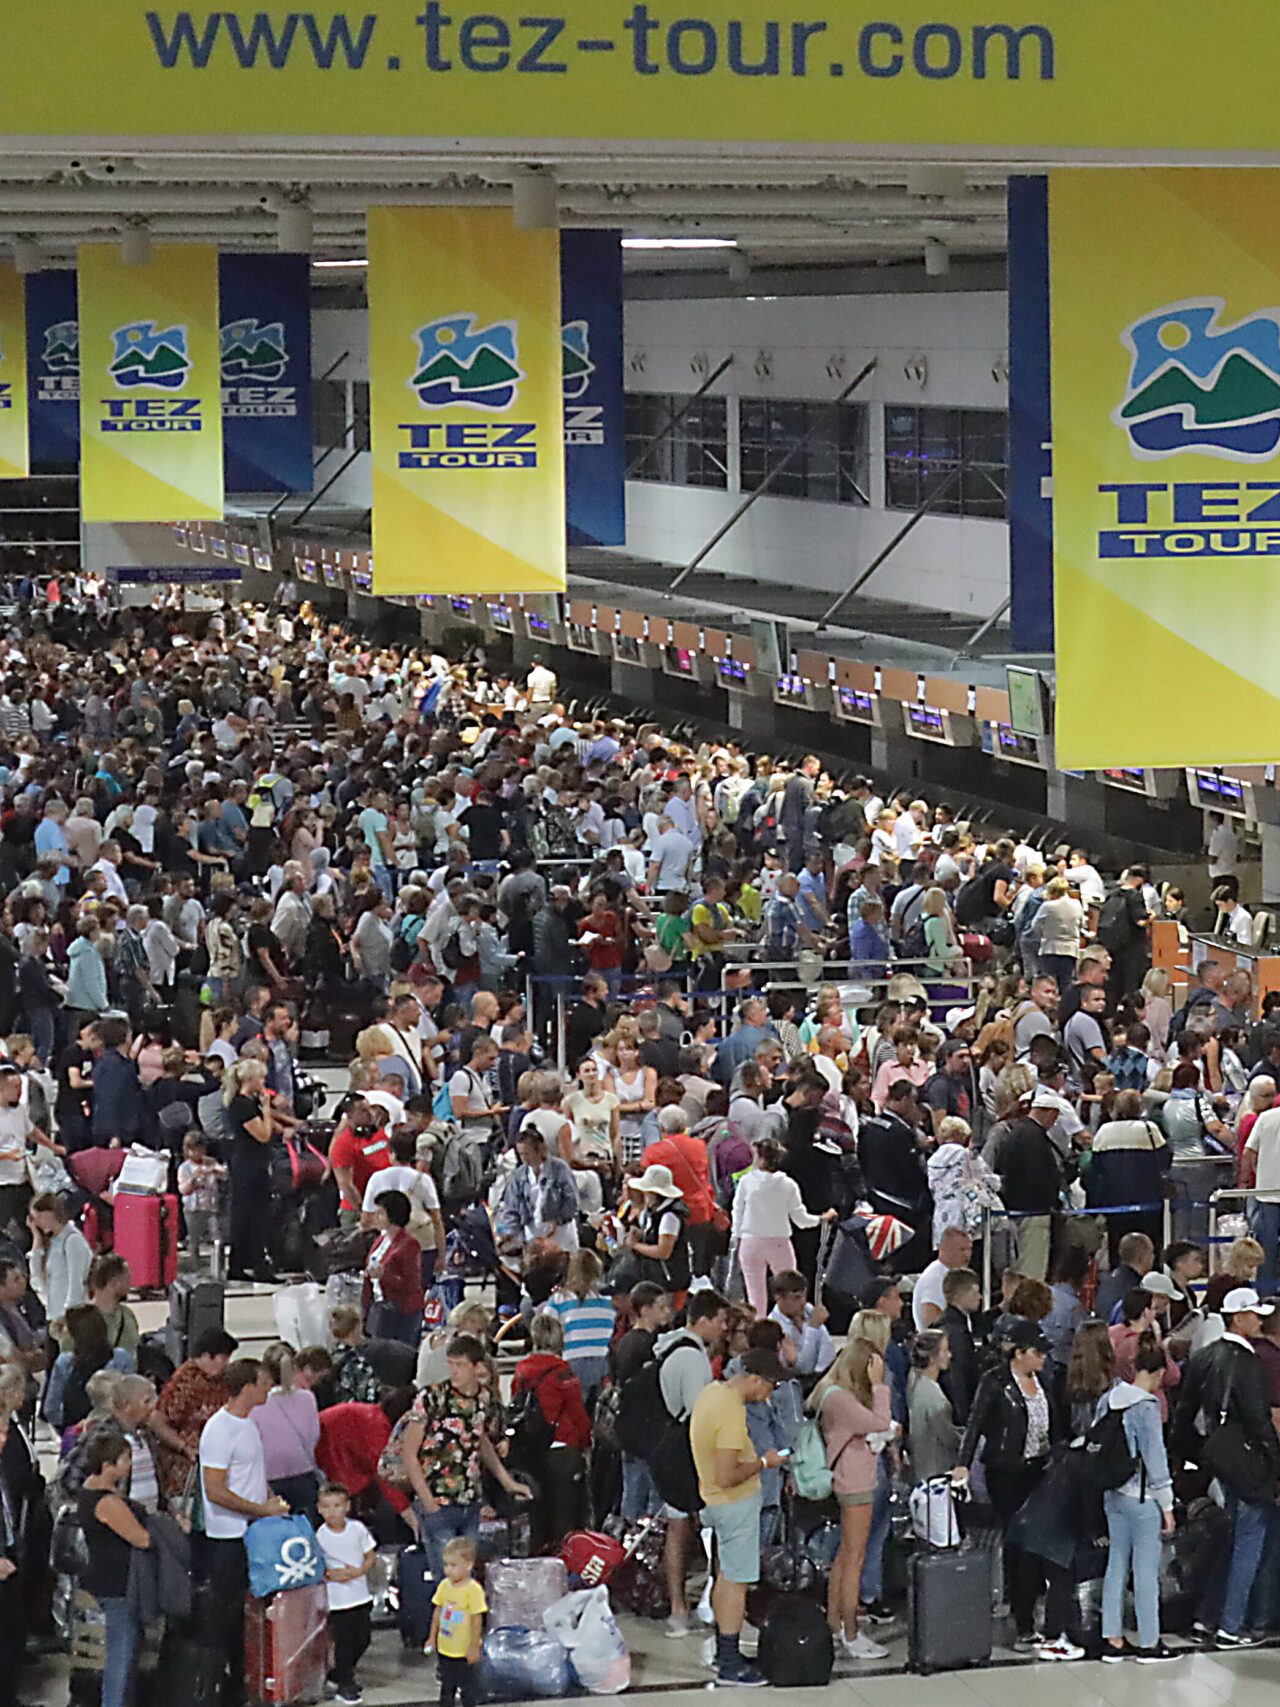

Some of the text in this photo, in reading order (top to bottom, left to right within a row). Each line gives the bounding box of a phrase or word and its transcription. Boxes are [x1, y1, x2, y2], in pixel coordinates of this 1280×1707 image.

[145, 1, 1055, 80] www.tez-tour.com
[38, 376, 80, 391] TE
[100, 400, 202, 418] TEZ
[111, 421, 193, 431] TOUR
[398, 423, 537, 448] TEZ
[412, 453, 524, 467] TOUR
